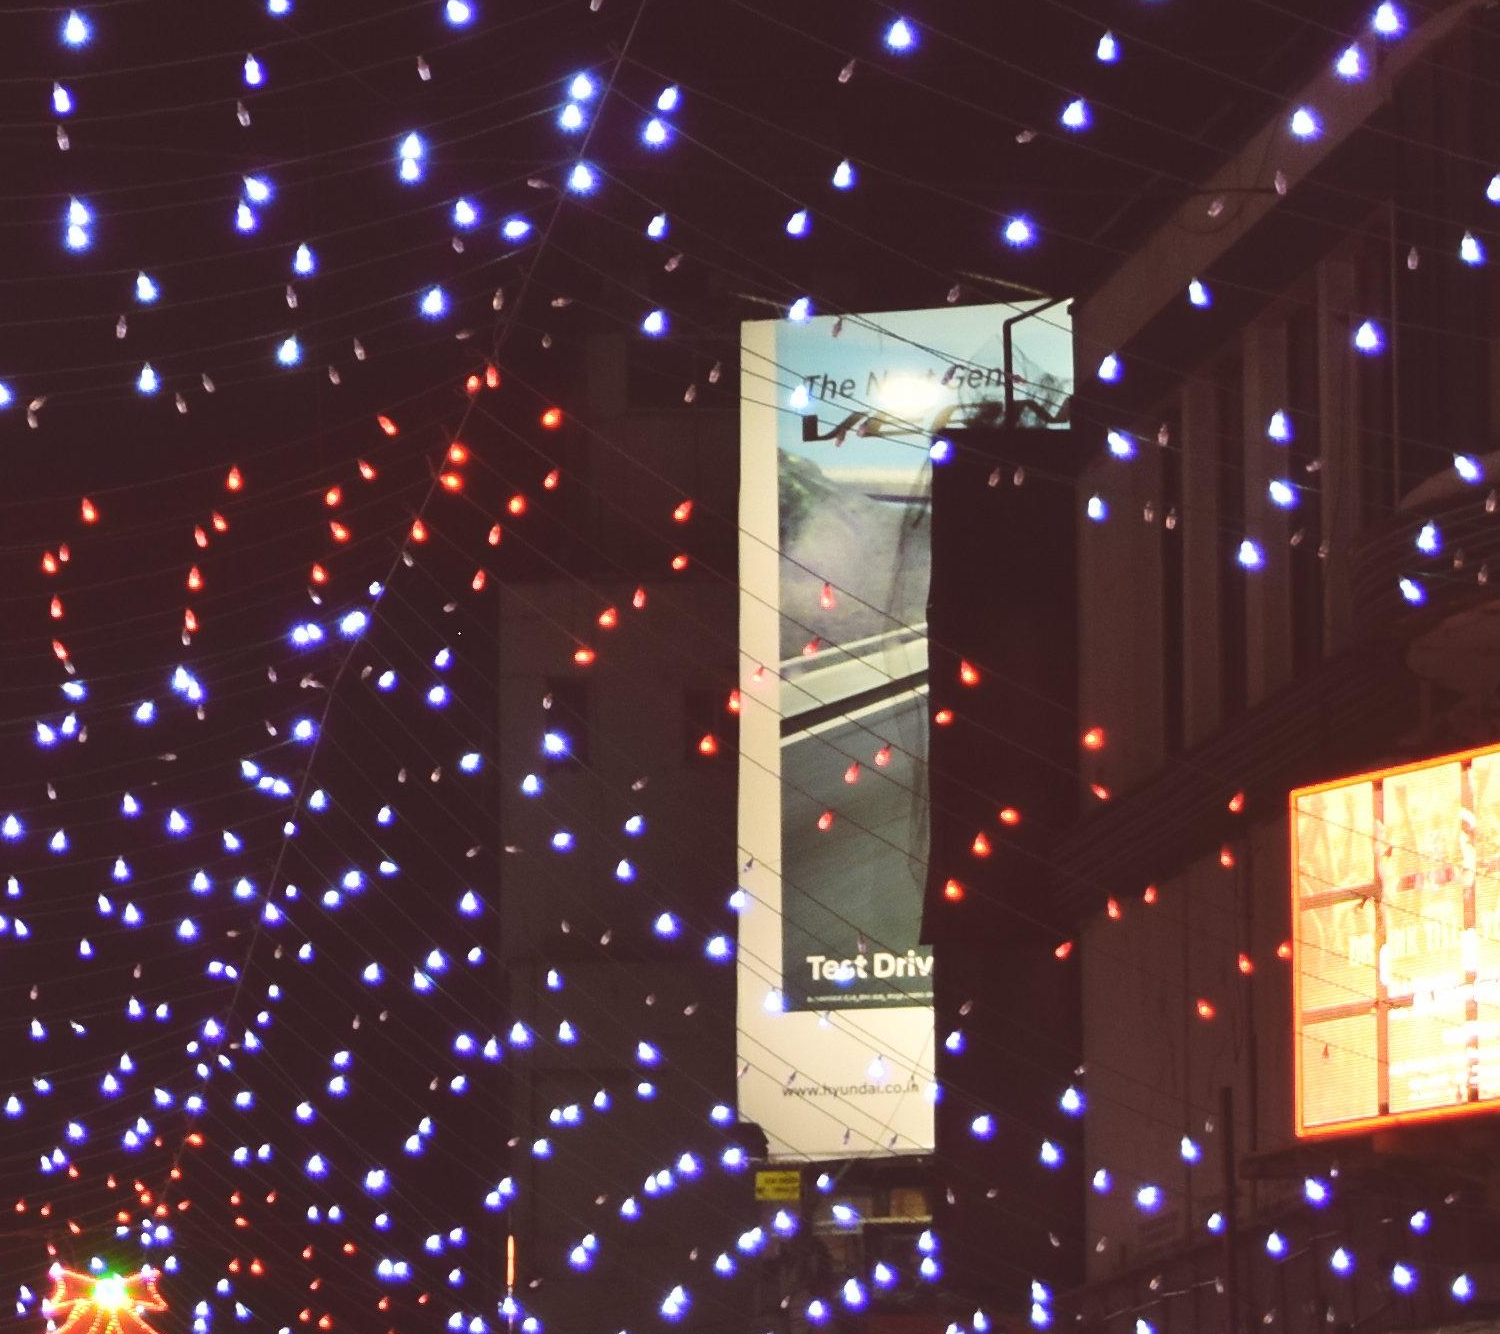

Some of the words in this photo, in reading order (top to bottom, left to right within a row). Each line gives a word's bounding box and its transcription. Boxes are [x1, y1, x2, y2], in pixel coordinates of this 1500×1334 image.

[805, 373, 856, 400] The
[806, 954, 868, 981] Test
[873, 949, 935, 979] Driv
[783, 1082, 919, 1098] www.hyundai.co.in
